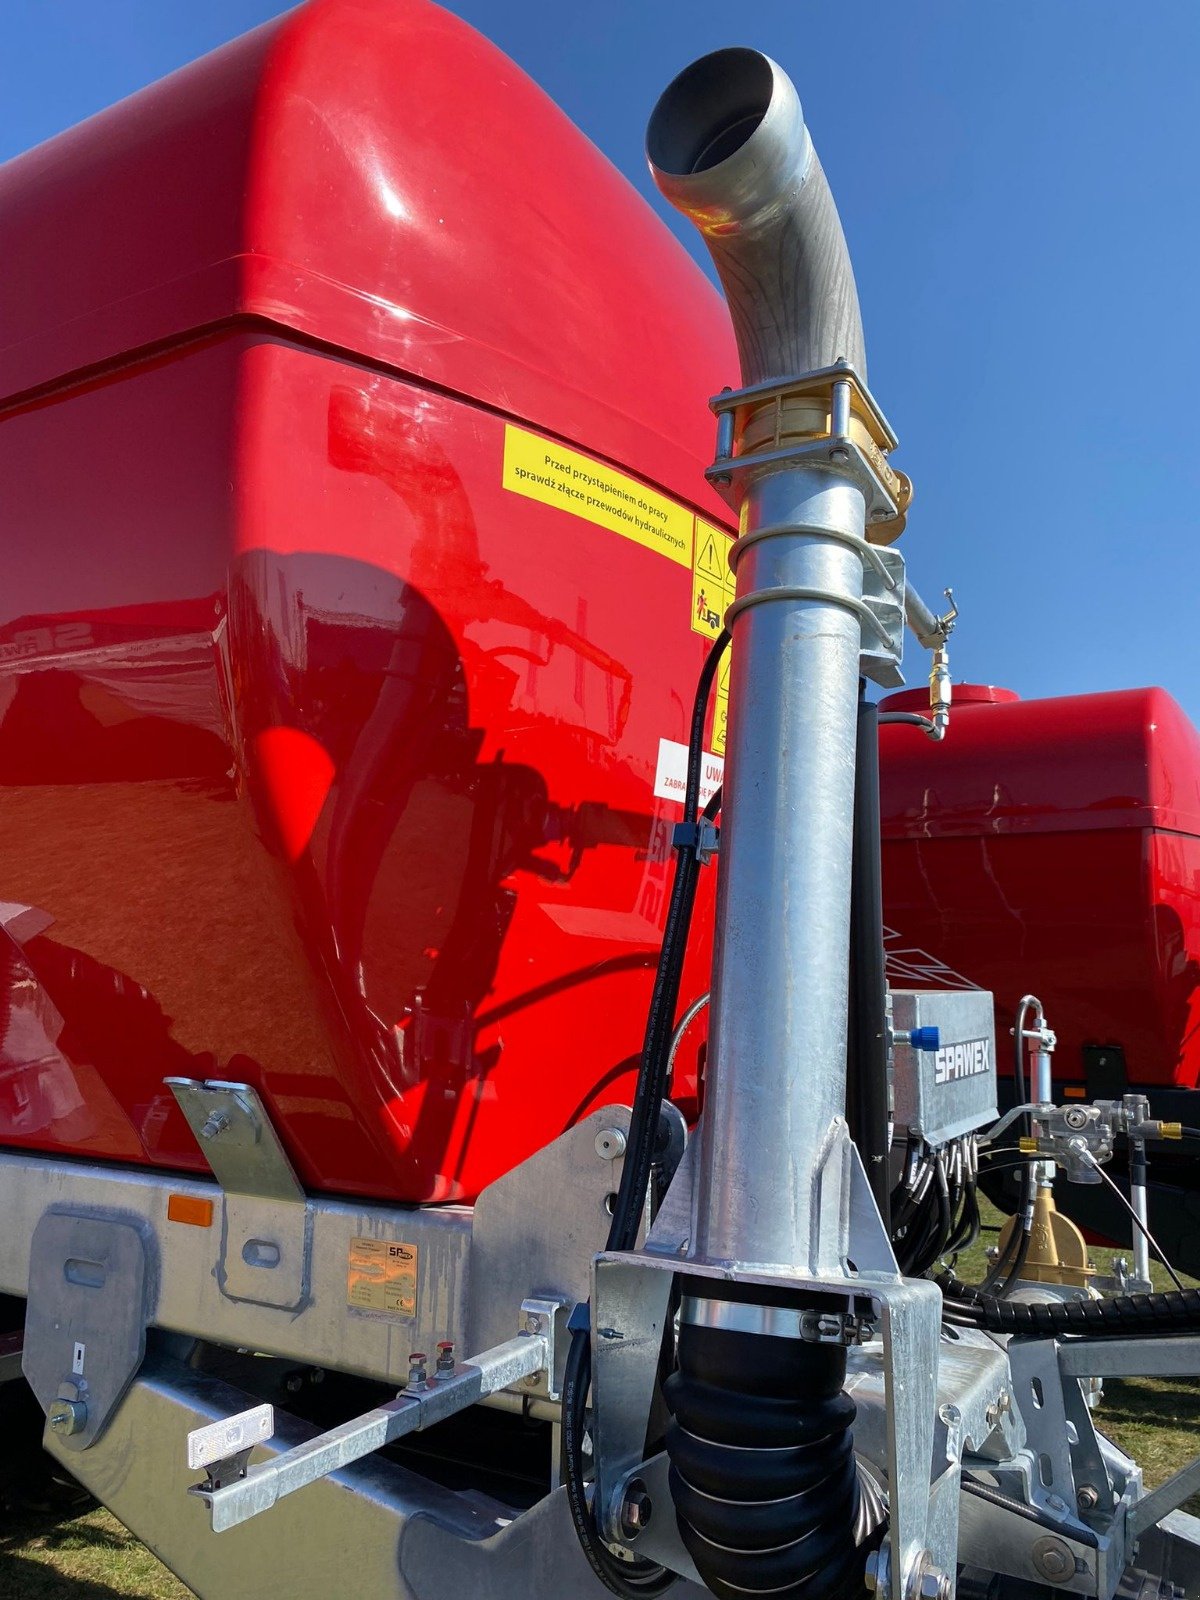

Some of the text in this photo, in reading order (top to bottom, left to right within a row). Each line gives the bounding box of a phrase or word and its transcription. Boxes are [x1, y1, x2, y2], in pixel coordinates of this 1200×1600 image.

[515, 467, 686, 550] sprawdź złącze przewodów hydraulicznych
[544, 455, 668, 522] Przed przystąpieniem do pracy
[935, 1040, 989, 1083] SPAWEX
